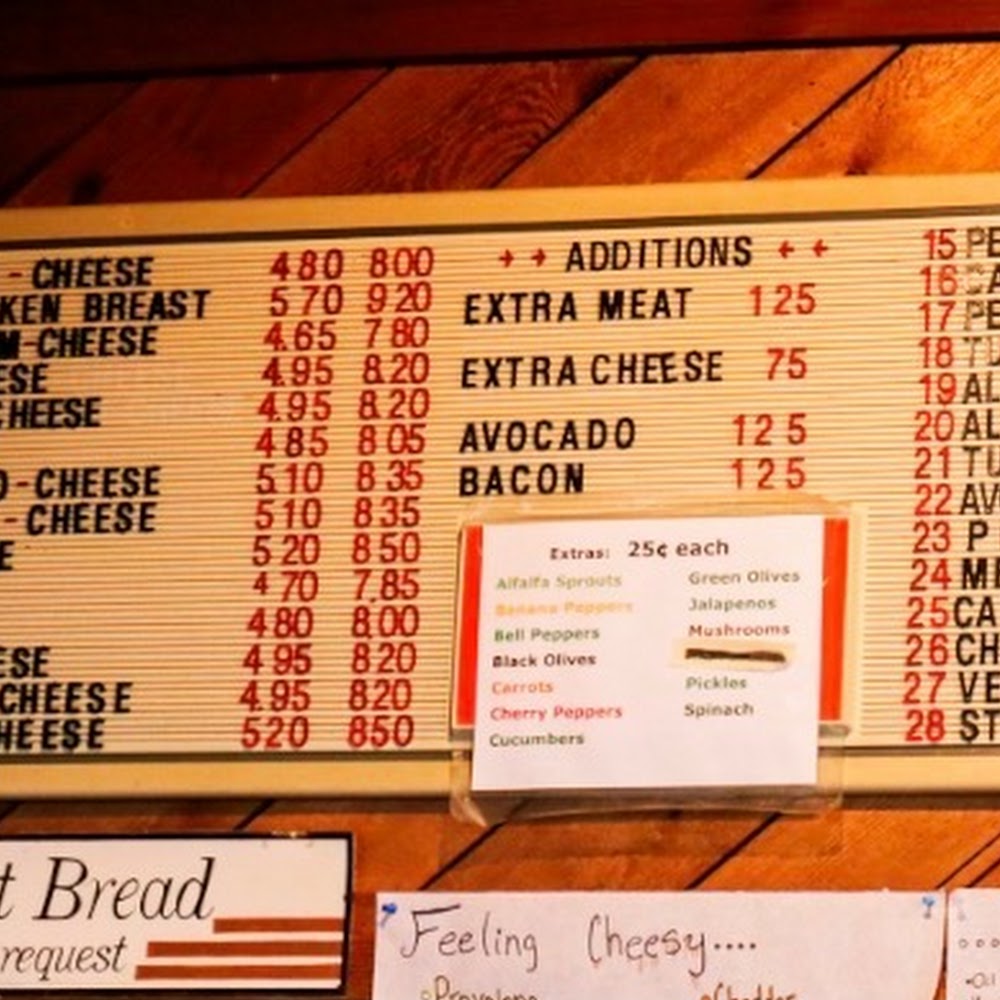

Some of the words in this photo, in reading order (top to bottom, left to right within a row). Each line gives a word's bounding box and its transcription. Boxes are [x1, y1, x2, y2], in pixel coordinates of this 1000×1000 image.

[565, 236, 753, 272] ADDITIONS
[923, 229, 957, 260] 15
[369, 247, 434, 278] 800
[920, 264, 957, 296] 16
[83, 289, 211, 322] BREAST
[367, 282, 432, 314] 920
[464, 291, 578, 325] EXTRA
[599, 288, 693, 321] MEAT
[750, 283, 817, 316] 125
[919, 301, 955, 332] 17
[461, 355, 577, 388] EXTRA
[591, 351, 723, 385] CHEESE
[767, 348, 808, 380] 75
[918, 337, 953, 368] 18
[919, 373, 957, 405] 19
[459, 417, 636, 453] AVOCADO
[914, 411, 954, 442] 20
[914, 446, 951, 479] 21
[459, 462, 585, 496] BACON
[354, 497, 420, 528] 835
[914, 484, 952, 516] 22
[352, 533, 420, 564] 850
[550, 547, 610, 561] Extras:
[676, 539, 730, 557] each
[912, 521, 951, 552] 23
[556, 574, 622, 591] Sprouts
[688, 571, 741, 585] Green
[747, 569, 801, 584] Olives
[909, 559, 952, 590] 24
[564, 600, 633, 616] Peppers
[905, 597, 950, 630] 25
[494, 629, 525, 642] Bell
[531, 627, 600, 645] Peppers
[688, 622, 790, 638] Mushrooms
[352, 643, 417, 673] 820
[493, 654, 538, 668] Black
[544, 652, 596, 667] Olives
[905, 634, 950, 666] 26
[348, 679, 412, 710] 820
[492, 680, 554, 694] Carrots
[686, 675, 747, 691] Pickles
[903, 672, 946, 704] 27
[490, 707, 546, 724] Cherry
[553, 704, 623, 722] Peppers
[684, 702, 754, 718] Spinach
[905, 709, 947, 742] 28
[241, 717, 310, 748] 520
[348, 716, 414, 747] 850
[489, 732, 585, 748] Cucumbers
[32, 856, 216, 921] Bread
[400, 903, 540, 972] Feeling
[1, 936, 128, 982] request
